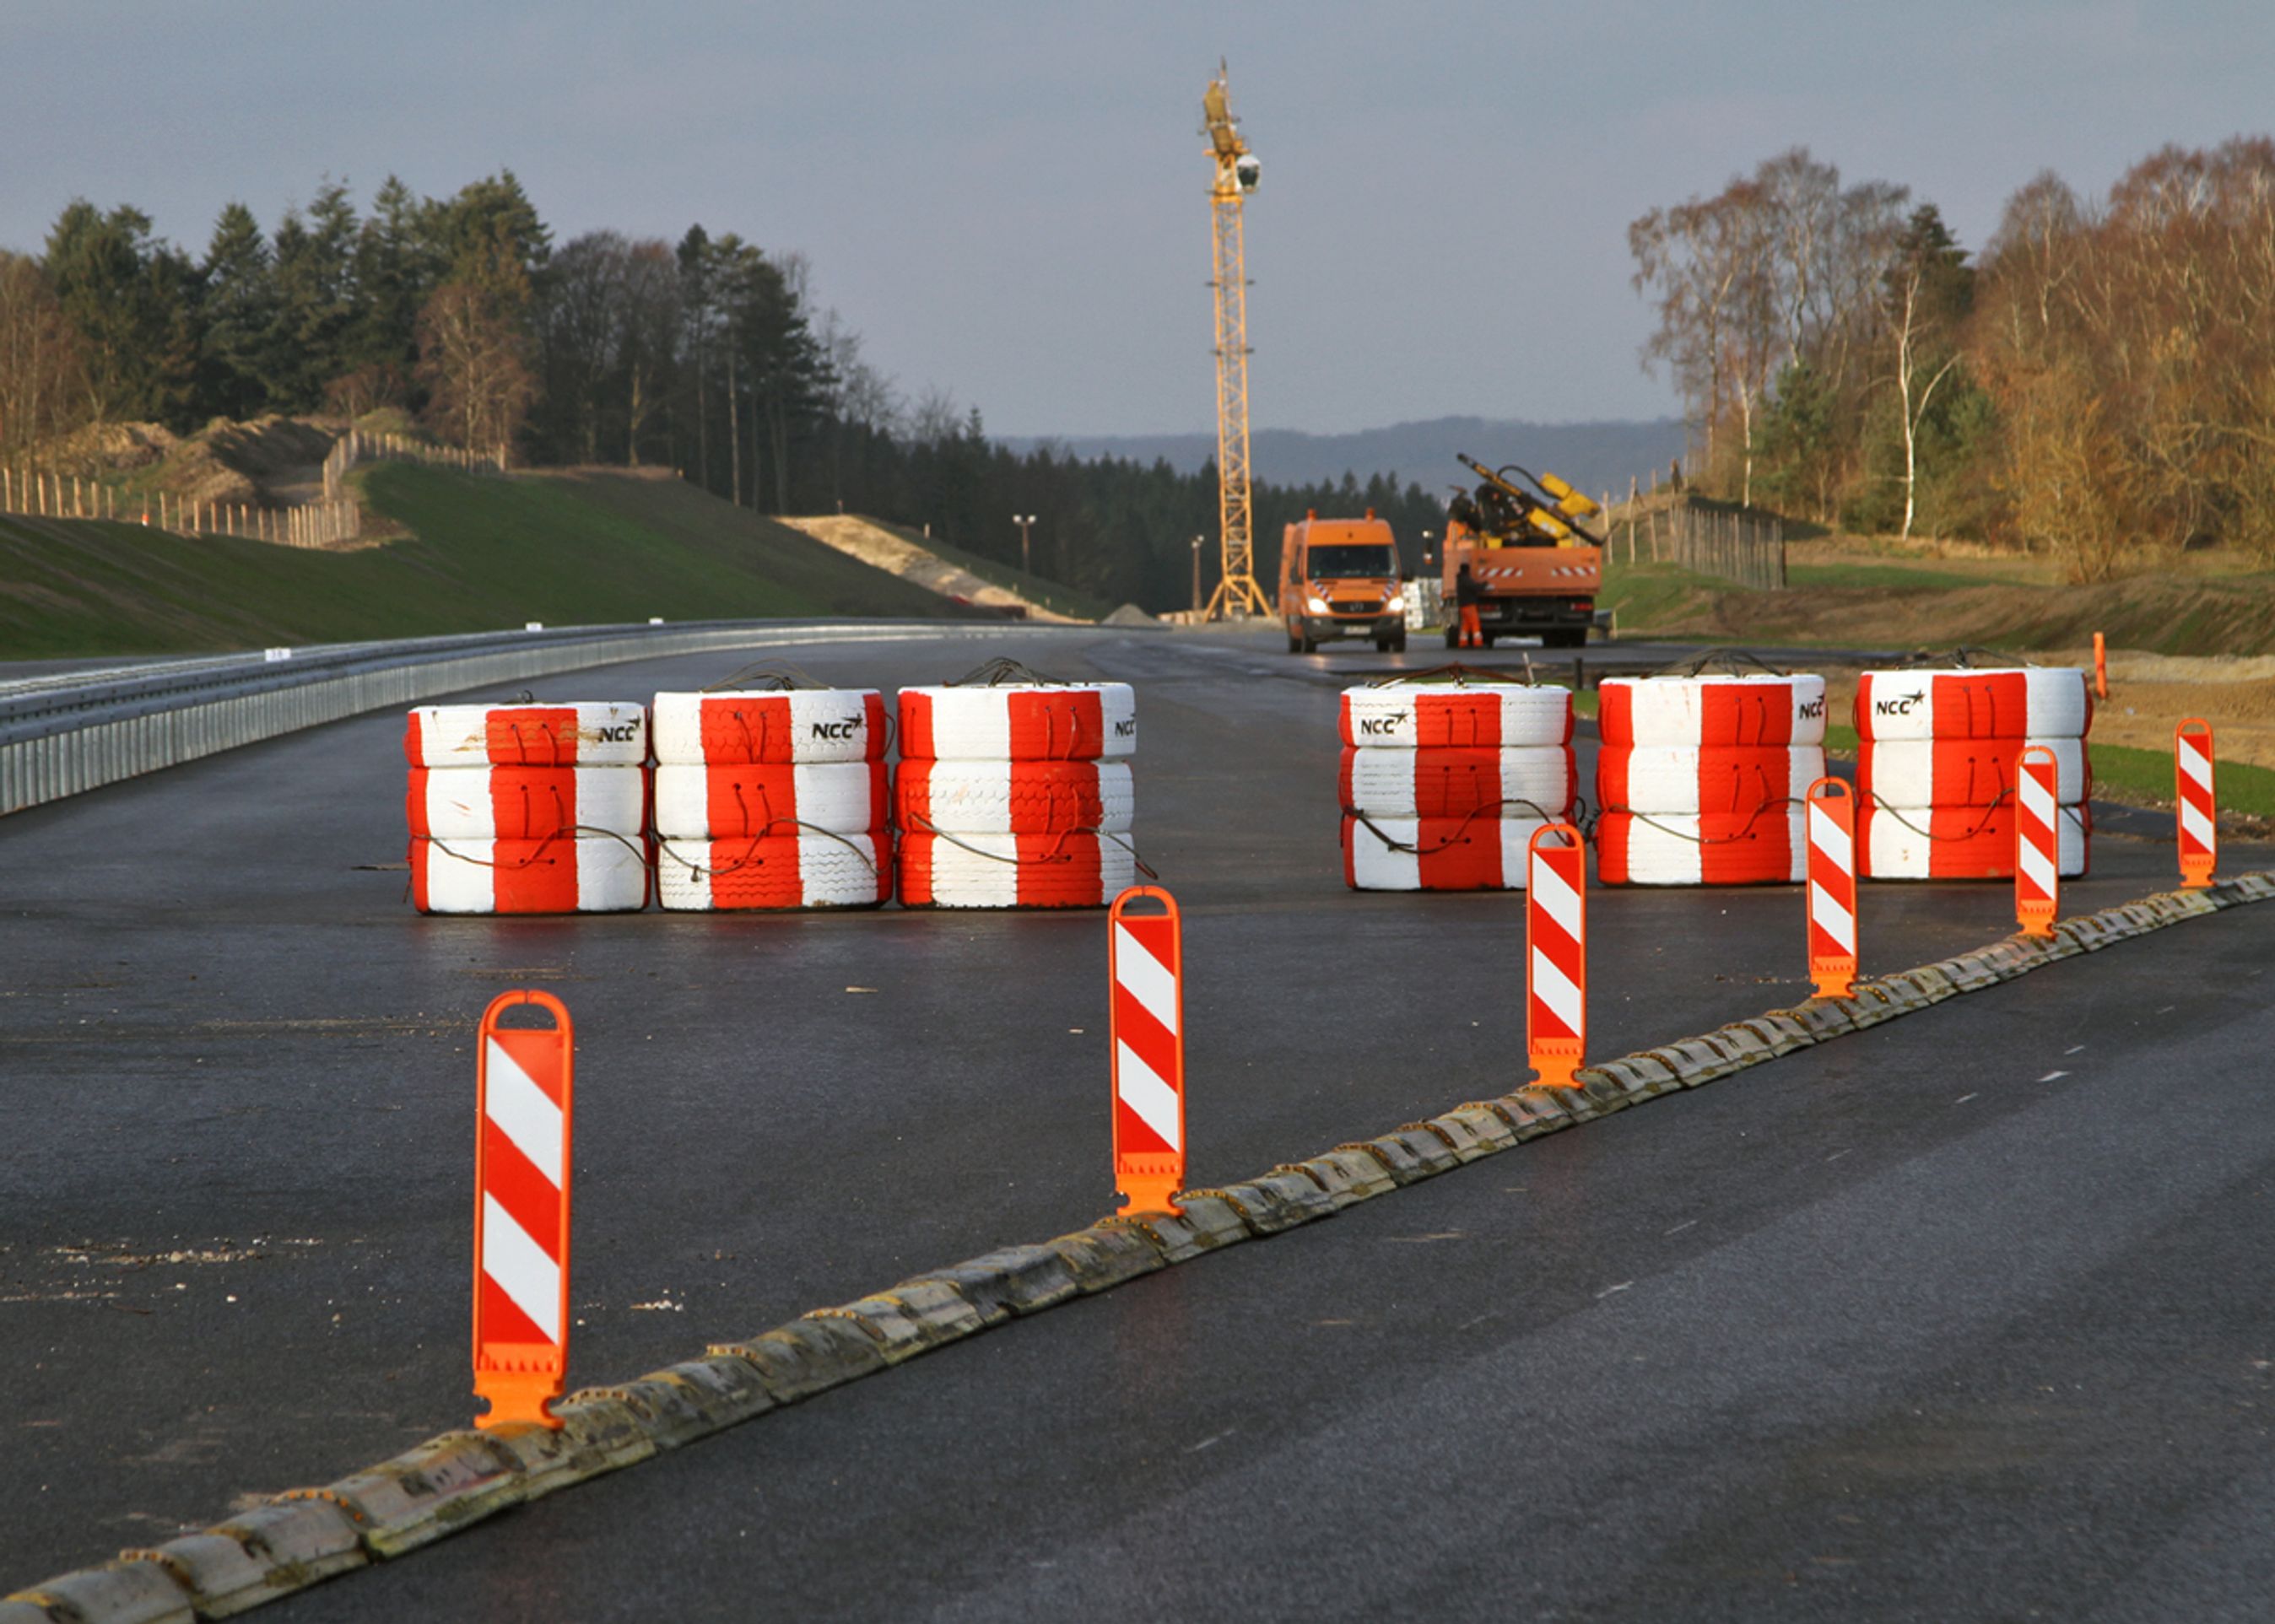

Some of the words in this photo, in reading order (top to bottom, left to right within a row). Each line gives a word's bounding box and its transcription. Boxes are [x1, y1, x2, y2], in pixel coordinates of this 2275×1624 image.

[1799, 703, 1824, 719] NCC
[1877, 701, 1910, 715] NCC
[599, 726, 635, 742] NCC
[812, 723, 853, 738] NCC
[1361, 720, 1395, 734] NCC
